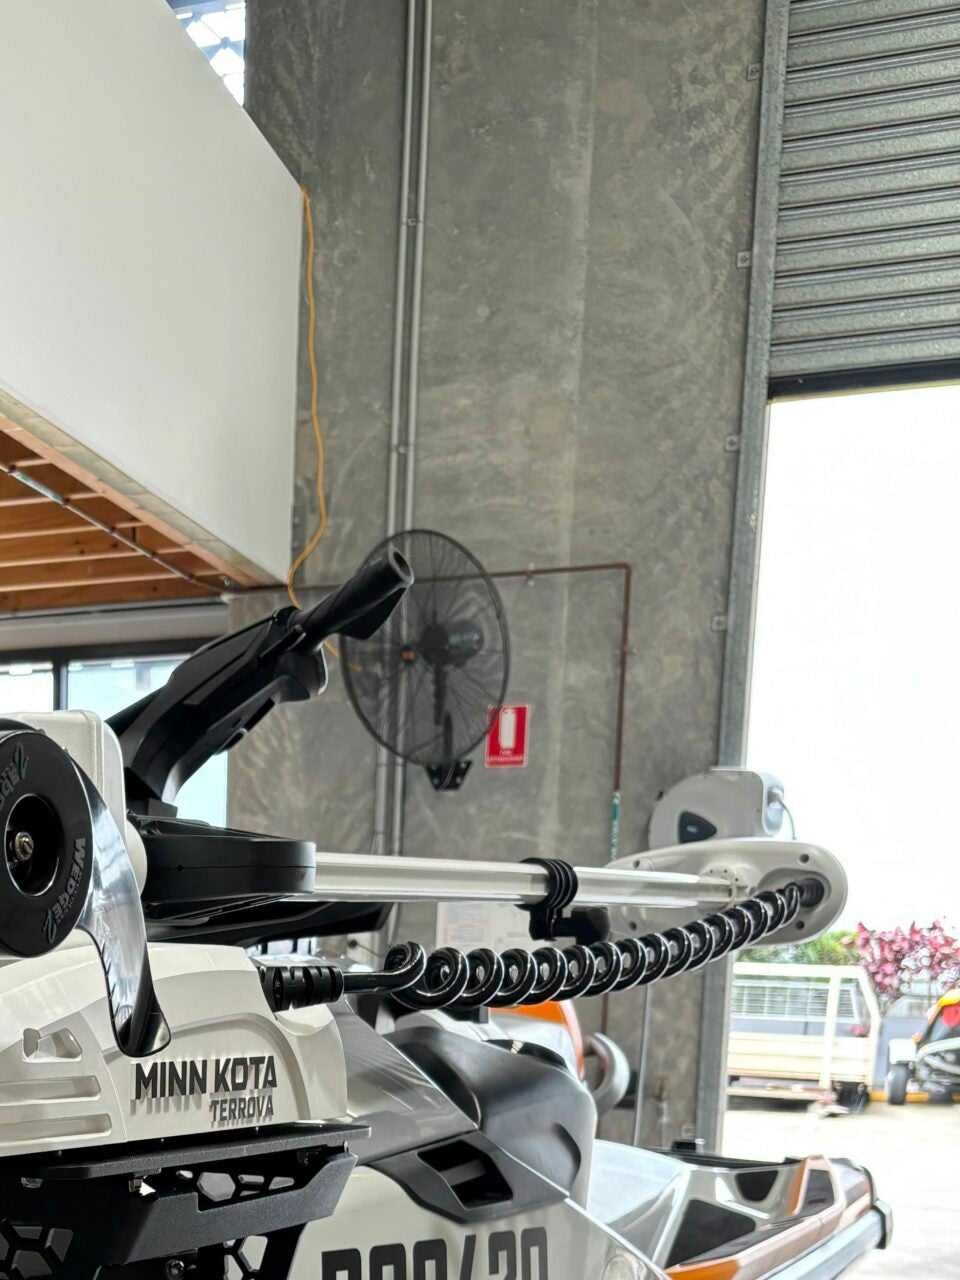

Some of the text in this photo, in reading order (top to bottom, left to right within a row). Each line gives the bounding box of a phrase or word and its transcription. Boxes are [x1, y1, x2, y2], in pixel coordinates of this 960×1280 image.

[53, 838, 86, 915] WEDGE
[134, 1055, 278, 1101] MINN KOTA
[210, 1094, 274, 1123] TERROVA
